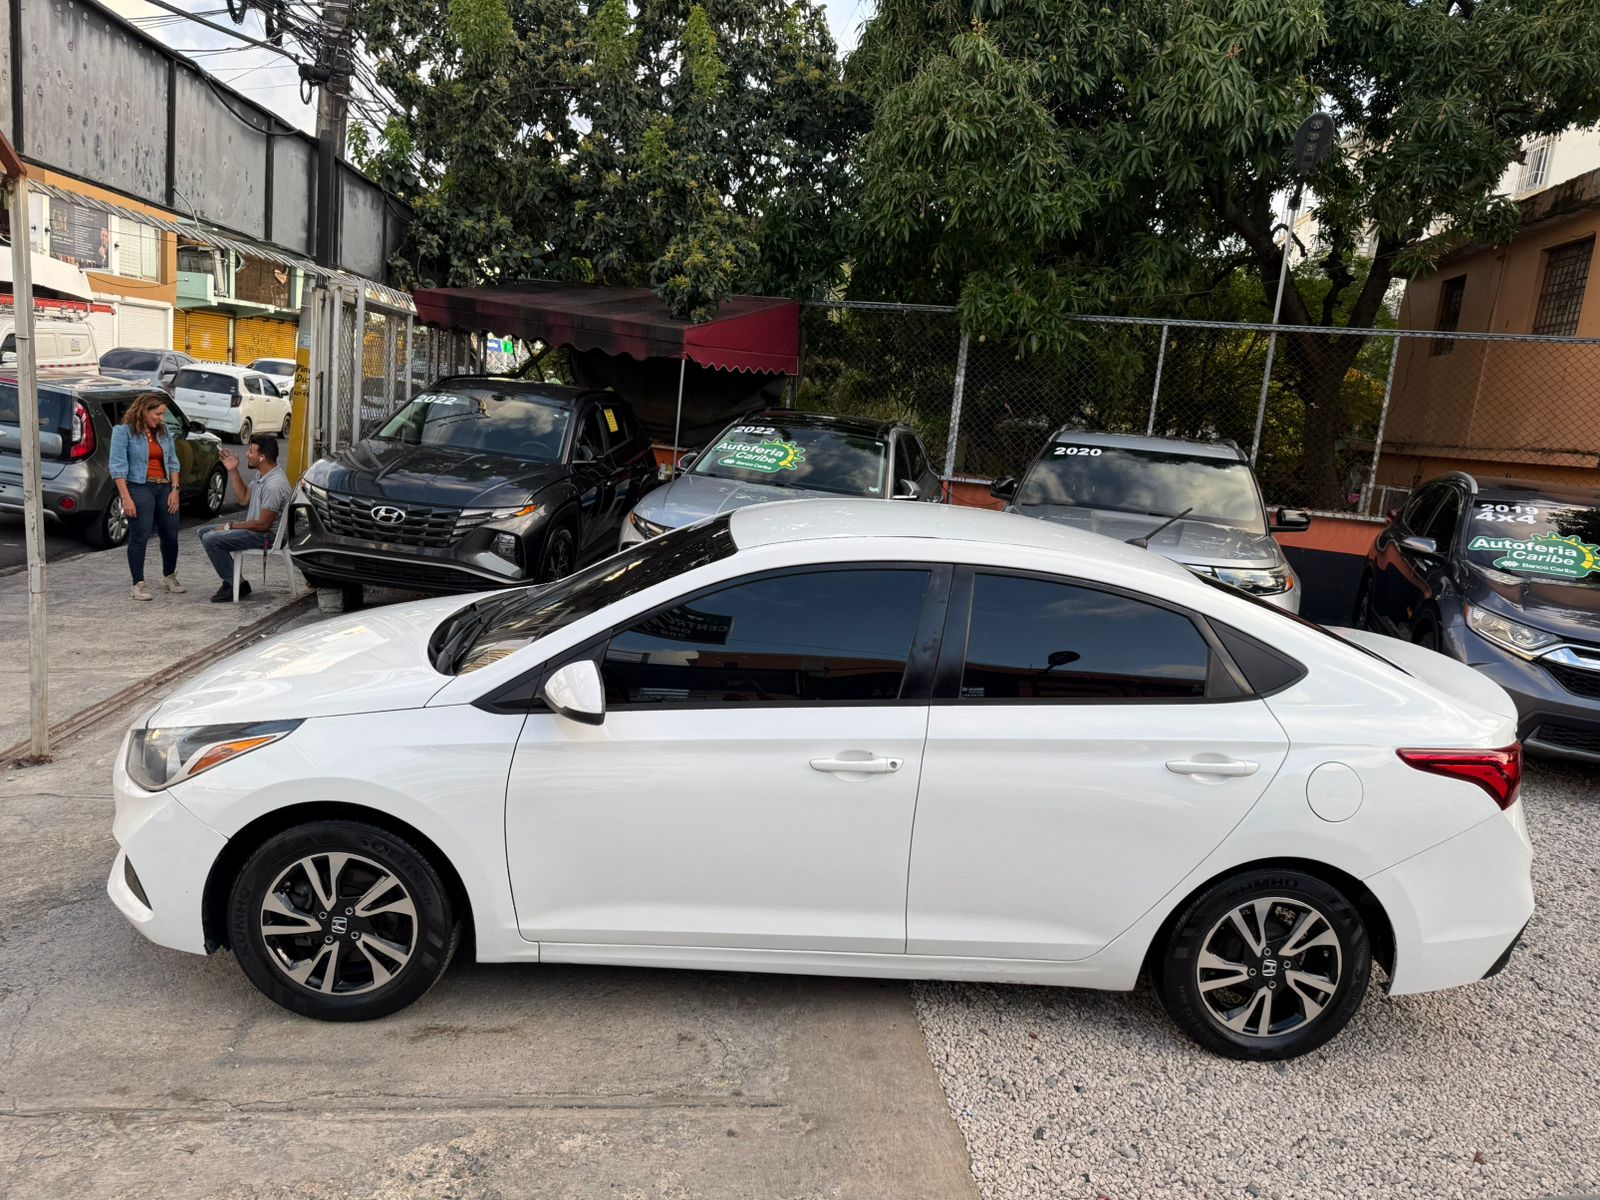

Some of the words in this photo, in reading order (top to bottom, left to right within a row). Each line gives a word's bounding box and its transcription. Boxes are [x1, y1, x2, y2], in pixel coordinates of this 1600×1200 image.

[413, 394, 457, 405] 2022
[734, 426, 776, 435] 2022
[717, 443, 784, 457] Autoferia
[1053, 447, 1102, 457] 2020
[735, 451, 777, 464] Caribe
[1480, 504, 1539, 515] 2019
[1475, 512, 1537, 524] 4x4
[1473, 538, 1577, 557] Autoferia
[1512, 550, 1574, 566] Caribe
[1521, 562, 1549, 570] Banco
[1549, 565, 1577, 574] Caribe
[233, 886, 251, 959] KUMHO
